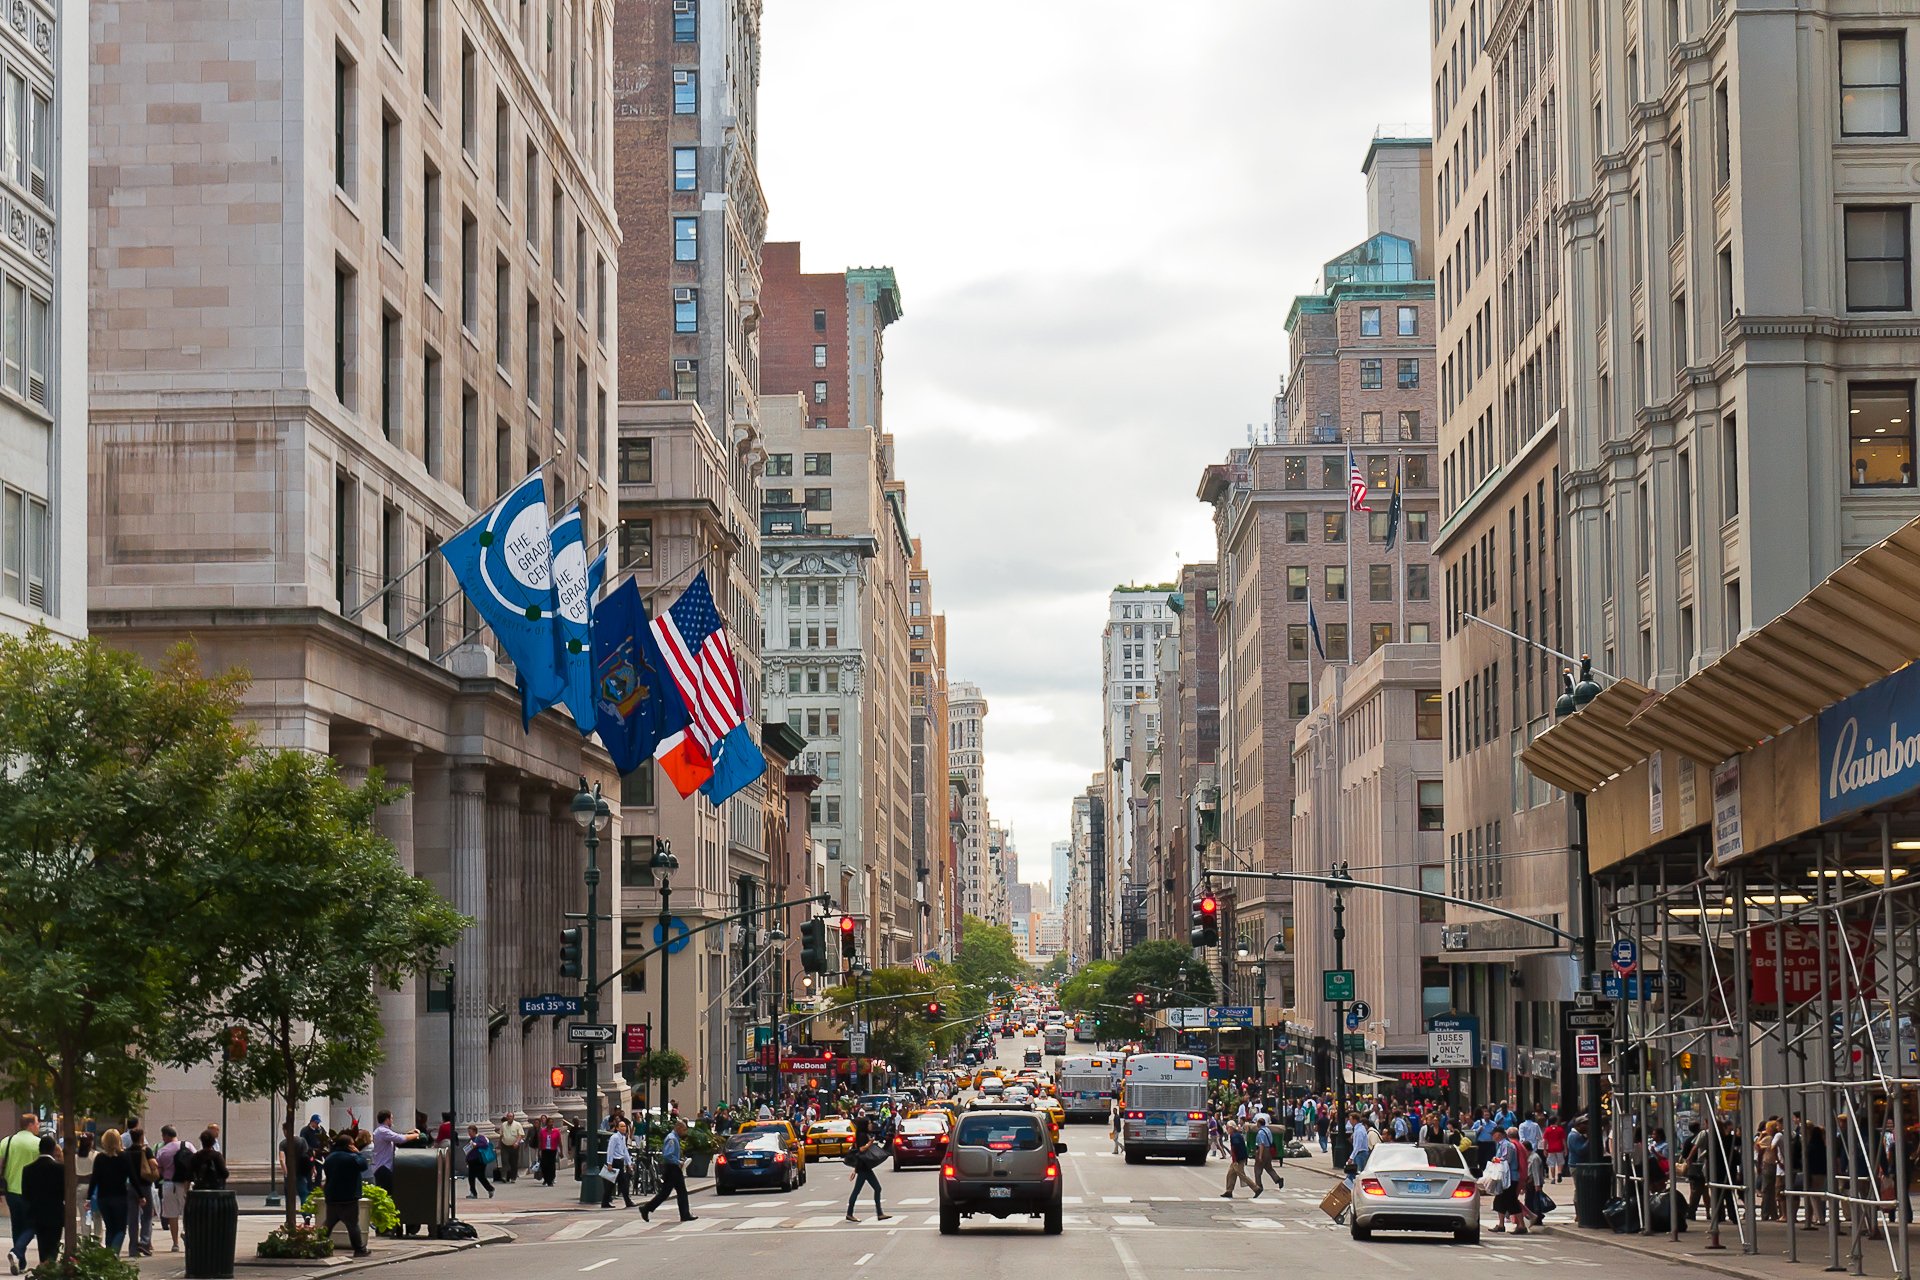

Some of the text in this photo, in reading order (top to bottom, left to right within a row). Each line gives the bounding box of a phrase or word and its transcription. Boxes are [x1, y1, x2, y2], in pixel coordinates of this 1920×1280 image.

[507, 533, 531, 556] THE
[518, 535, 550, 571] GRADU
[556, 569, 573, 588] HE
[561, 576, 586, 605] GRAD
[570, 599, 587, 619] CEN
[1829, 717, 1920, 799] Rainbo
[1765, 930, 1861, 951] BEADS
[525, 1001, 576, 1011] East 35th St
[1434, 1020, 1460, 1028] Empire
[1574, 1015, 1612, 1025] ONE WAY
[573, 1029, 608, 1037] ONE WAY
[1437, 1034, 1464, 1042] BUSES
[1439, 1046, 1460, 1054] ONLY
[792, 1062, 827, 1070] McDonal
